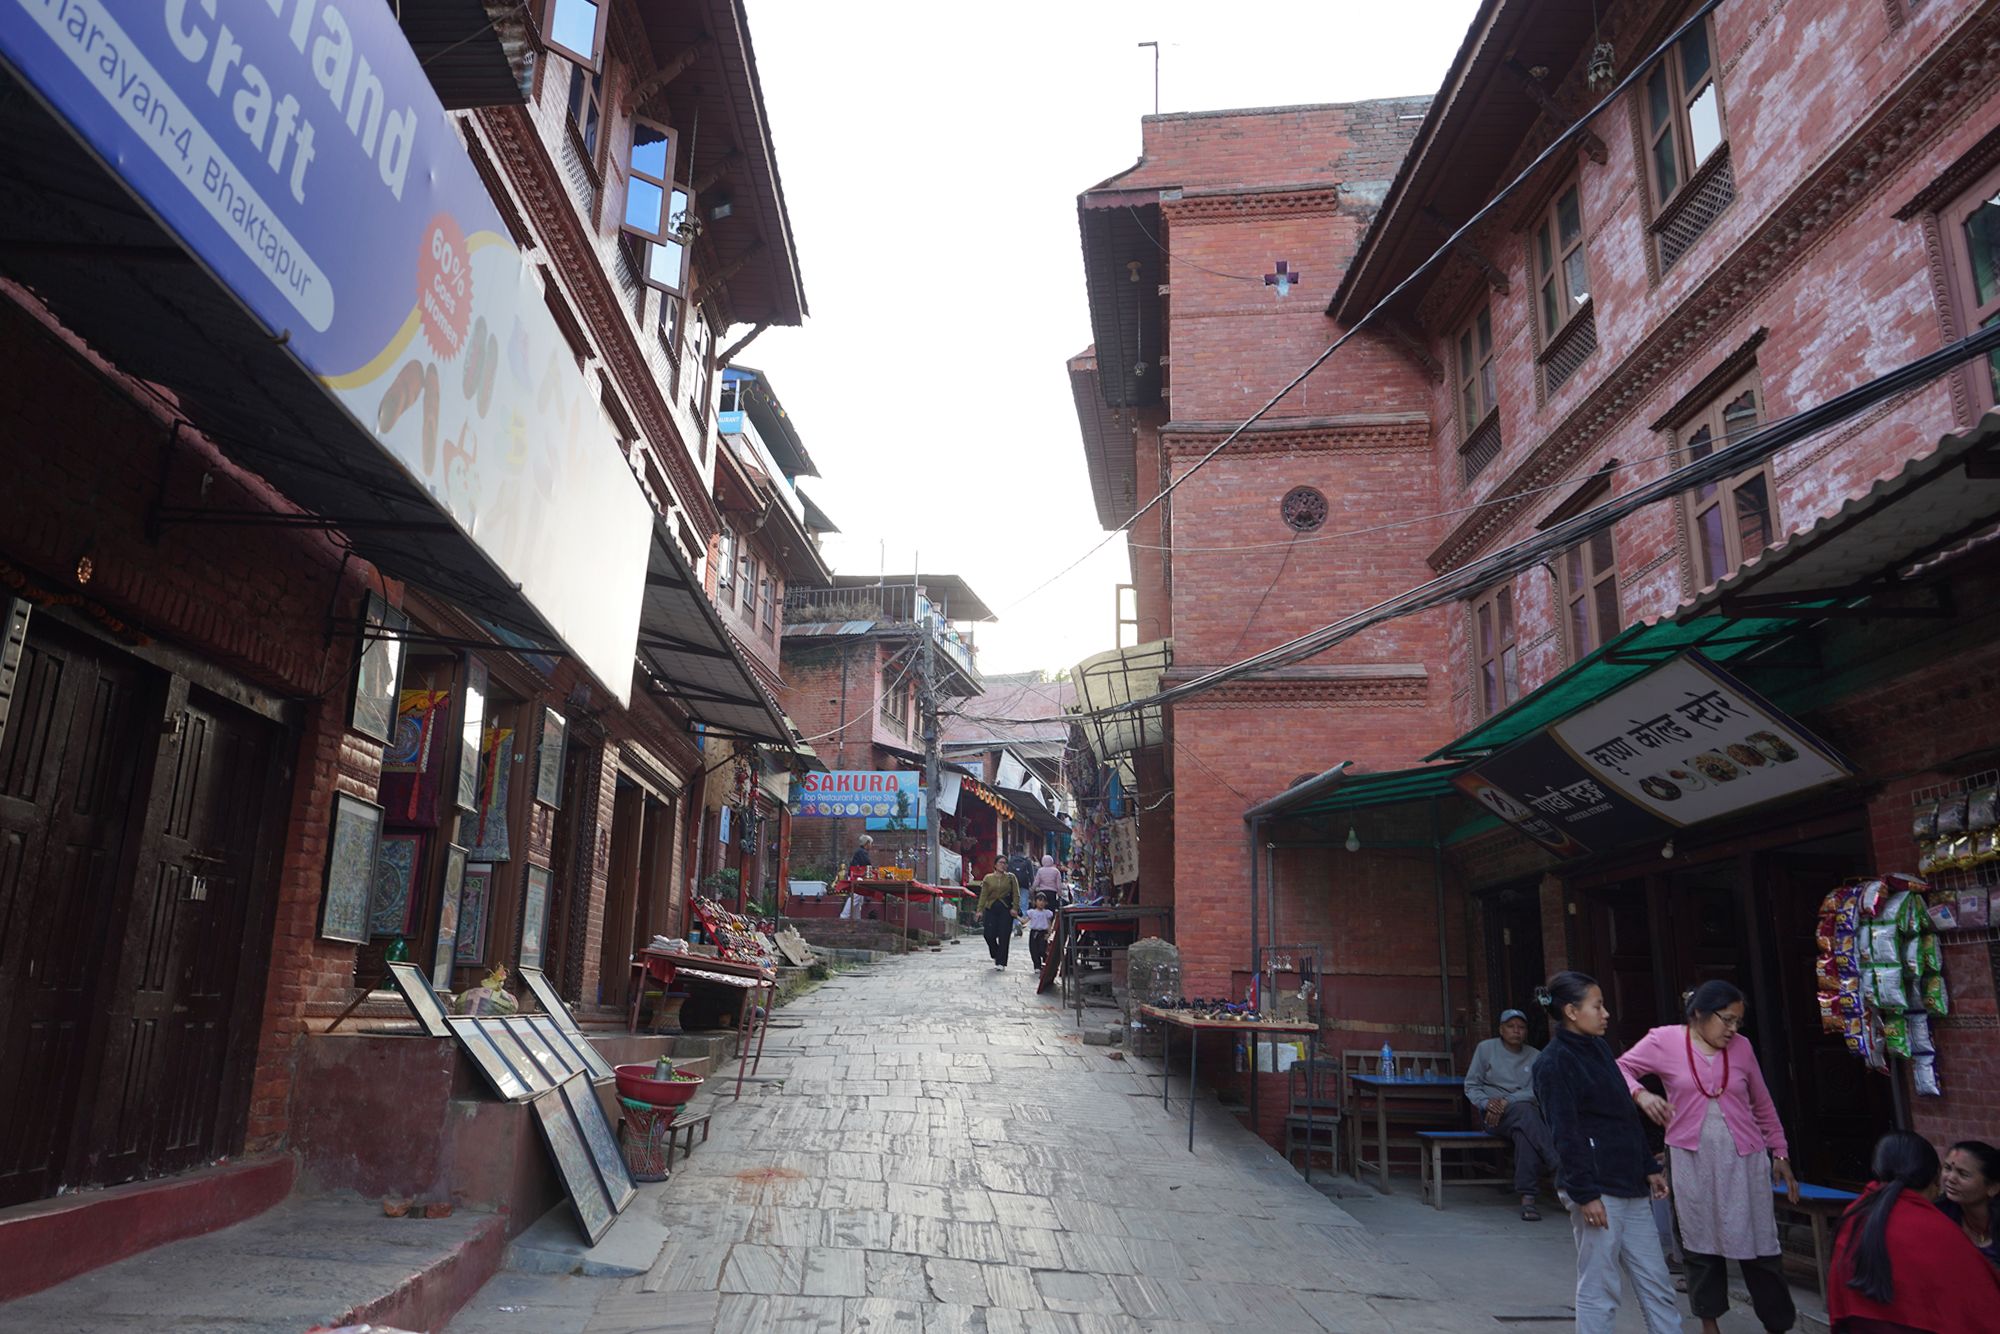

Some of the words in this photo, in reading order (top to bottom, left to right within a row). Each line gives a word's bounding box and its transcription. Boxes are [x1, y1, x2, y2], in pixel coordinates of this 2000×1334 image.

[165, 0, 316, 205] Craft
[203, 155, 312, 297] Bhaktapur
[431, 227, 466, 297] 60%
[424, 288, 459, 349] Women
[433, 273, 457, 316] Goes
[1627, 714, 1692, 749] कोल्ड
[1675, 689, 1750, 731] स्टोर
[805, 774, 899, 792] SAKURA
[817, 793, 854, 801] Restaurant
[861, 793, 882, 801] Home
